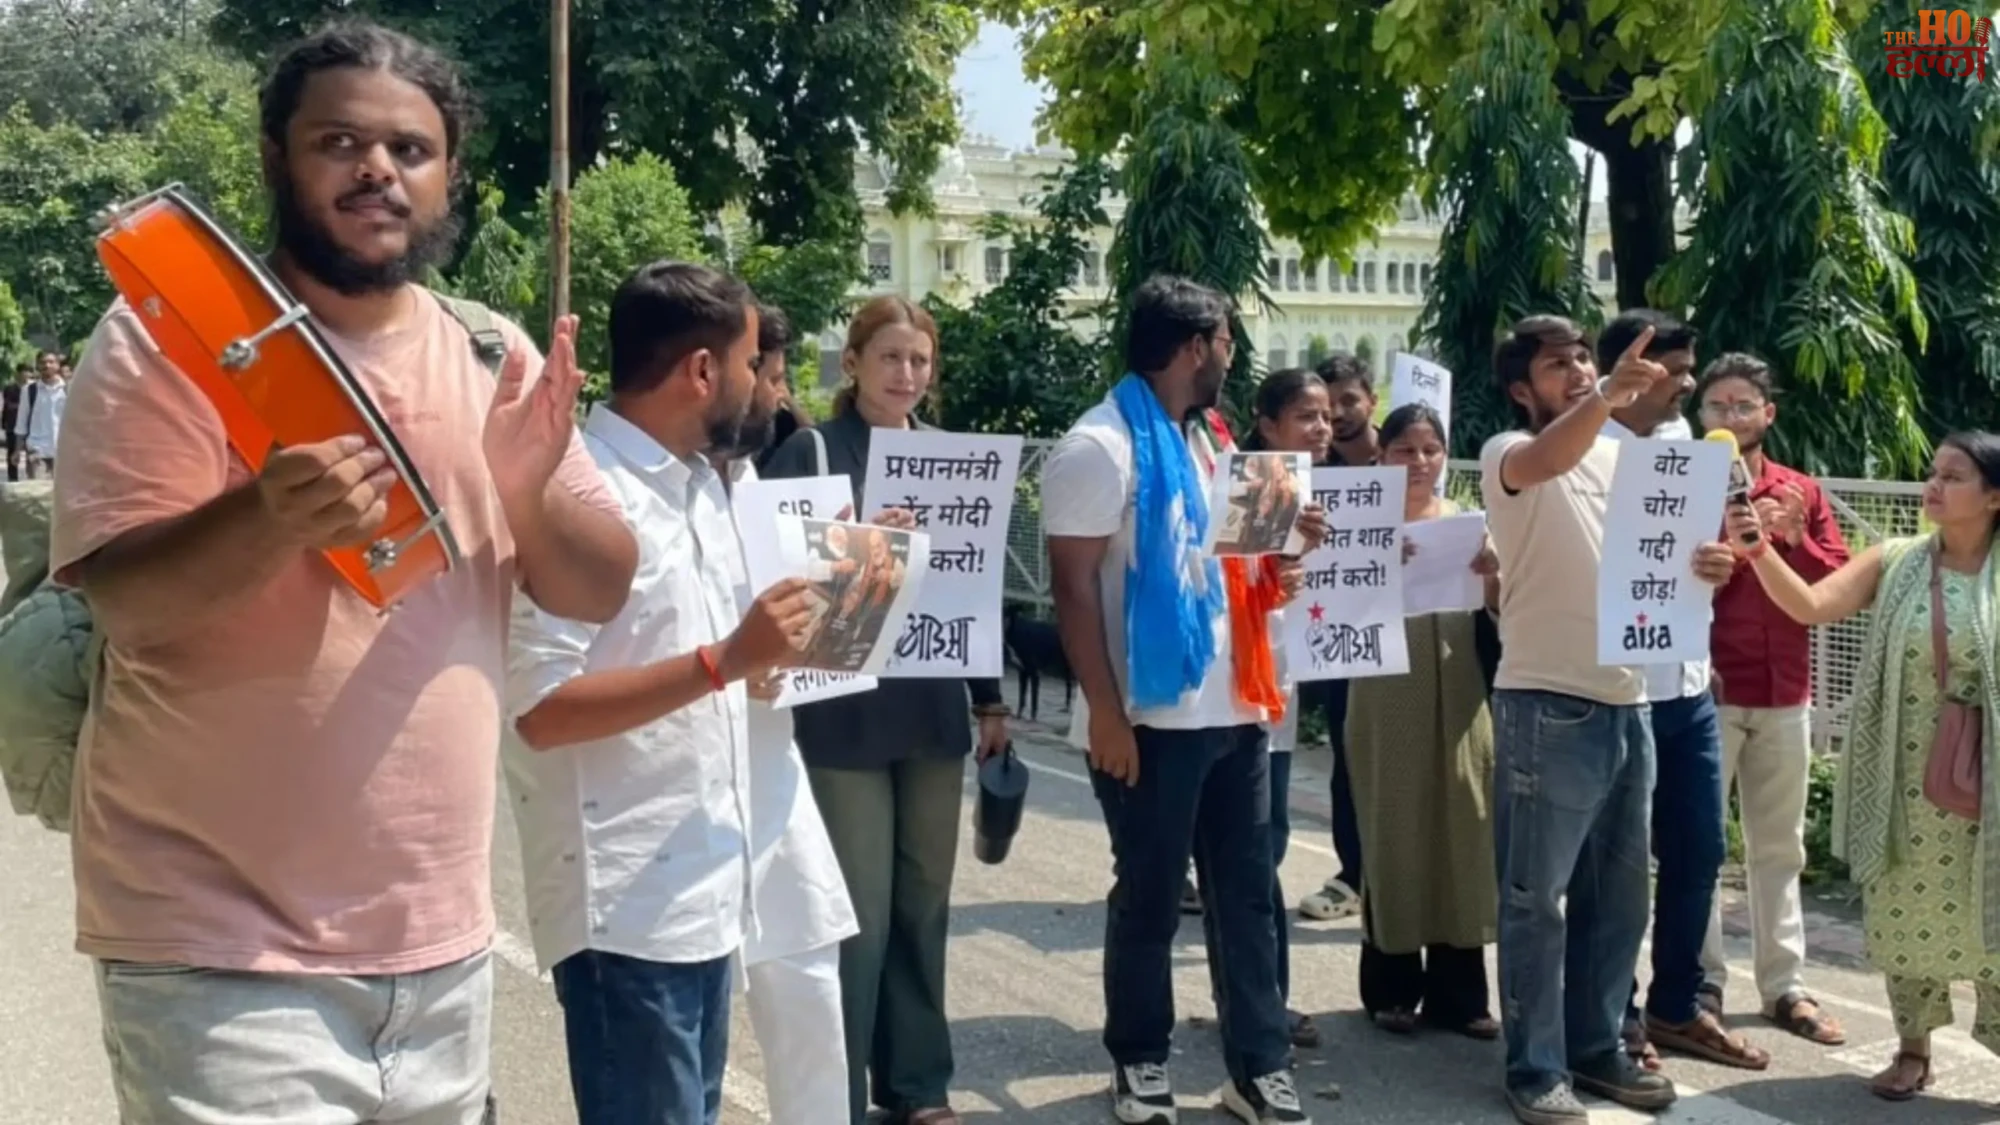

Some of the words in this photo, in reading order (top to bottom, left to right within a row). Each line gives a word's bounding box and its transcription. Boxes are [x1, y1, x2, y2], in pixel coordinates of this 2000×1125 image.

[885, 450, 1002, 480] प्रधानमंत्री
[1653, 448, 1692, 476] वोट
[1346, 481, 1384, 507] मंत्री
[1643, 489, 1687, 517] चोर!
[937, 496, 993, 528] मोदी
[1357, 527, 1396, 549] शाह
[1638, 531, 1676, 562] गद्दी
[929, 542, 985, 573] करो!
[1304, 561, 1339, 589] शर्म
[1342, 559, 1387, 588] करो!
[1630, 573, 1677, 606] छोड़!
[1622, 612, 1673, 651] aisa
